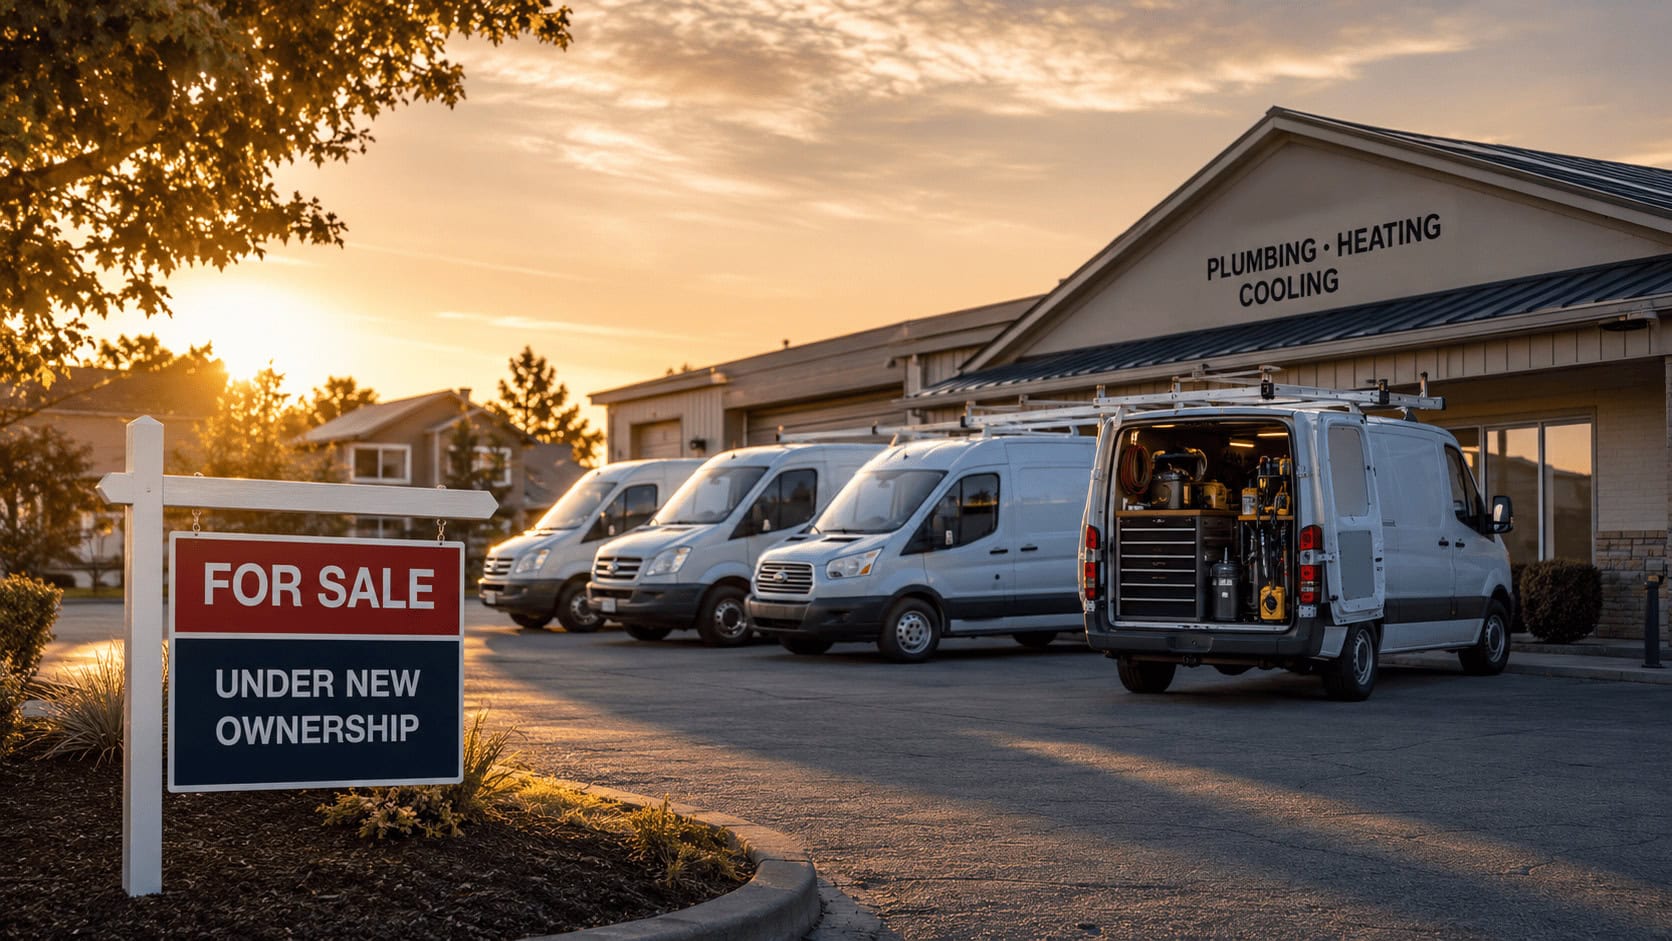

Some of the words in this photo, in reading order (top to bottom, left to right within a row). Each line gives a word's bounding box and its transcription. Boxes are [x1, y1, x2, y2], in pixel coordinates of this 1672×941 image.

[1207, 238, 1317, 281] PLUMBING
[1337, 213, 1441, 257] HEATING
[1239, 268, 1339, 307] COOLING
[203, 562, 302, 607] FOR
[317, 565, 435, 610] SALE
[215, 668, 335, 699] UNDER
[346, 669, 421, 698] NEW
[215, 714, 420, 746] OWNERSHIP
